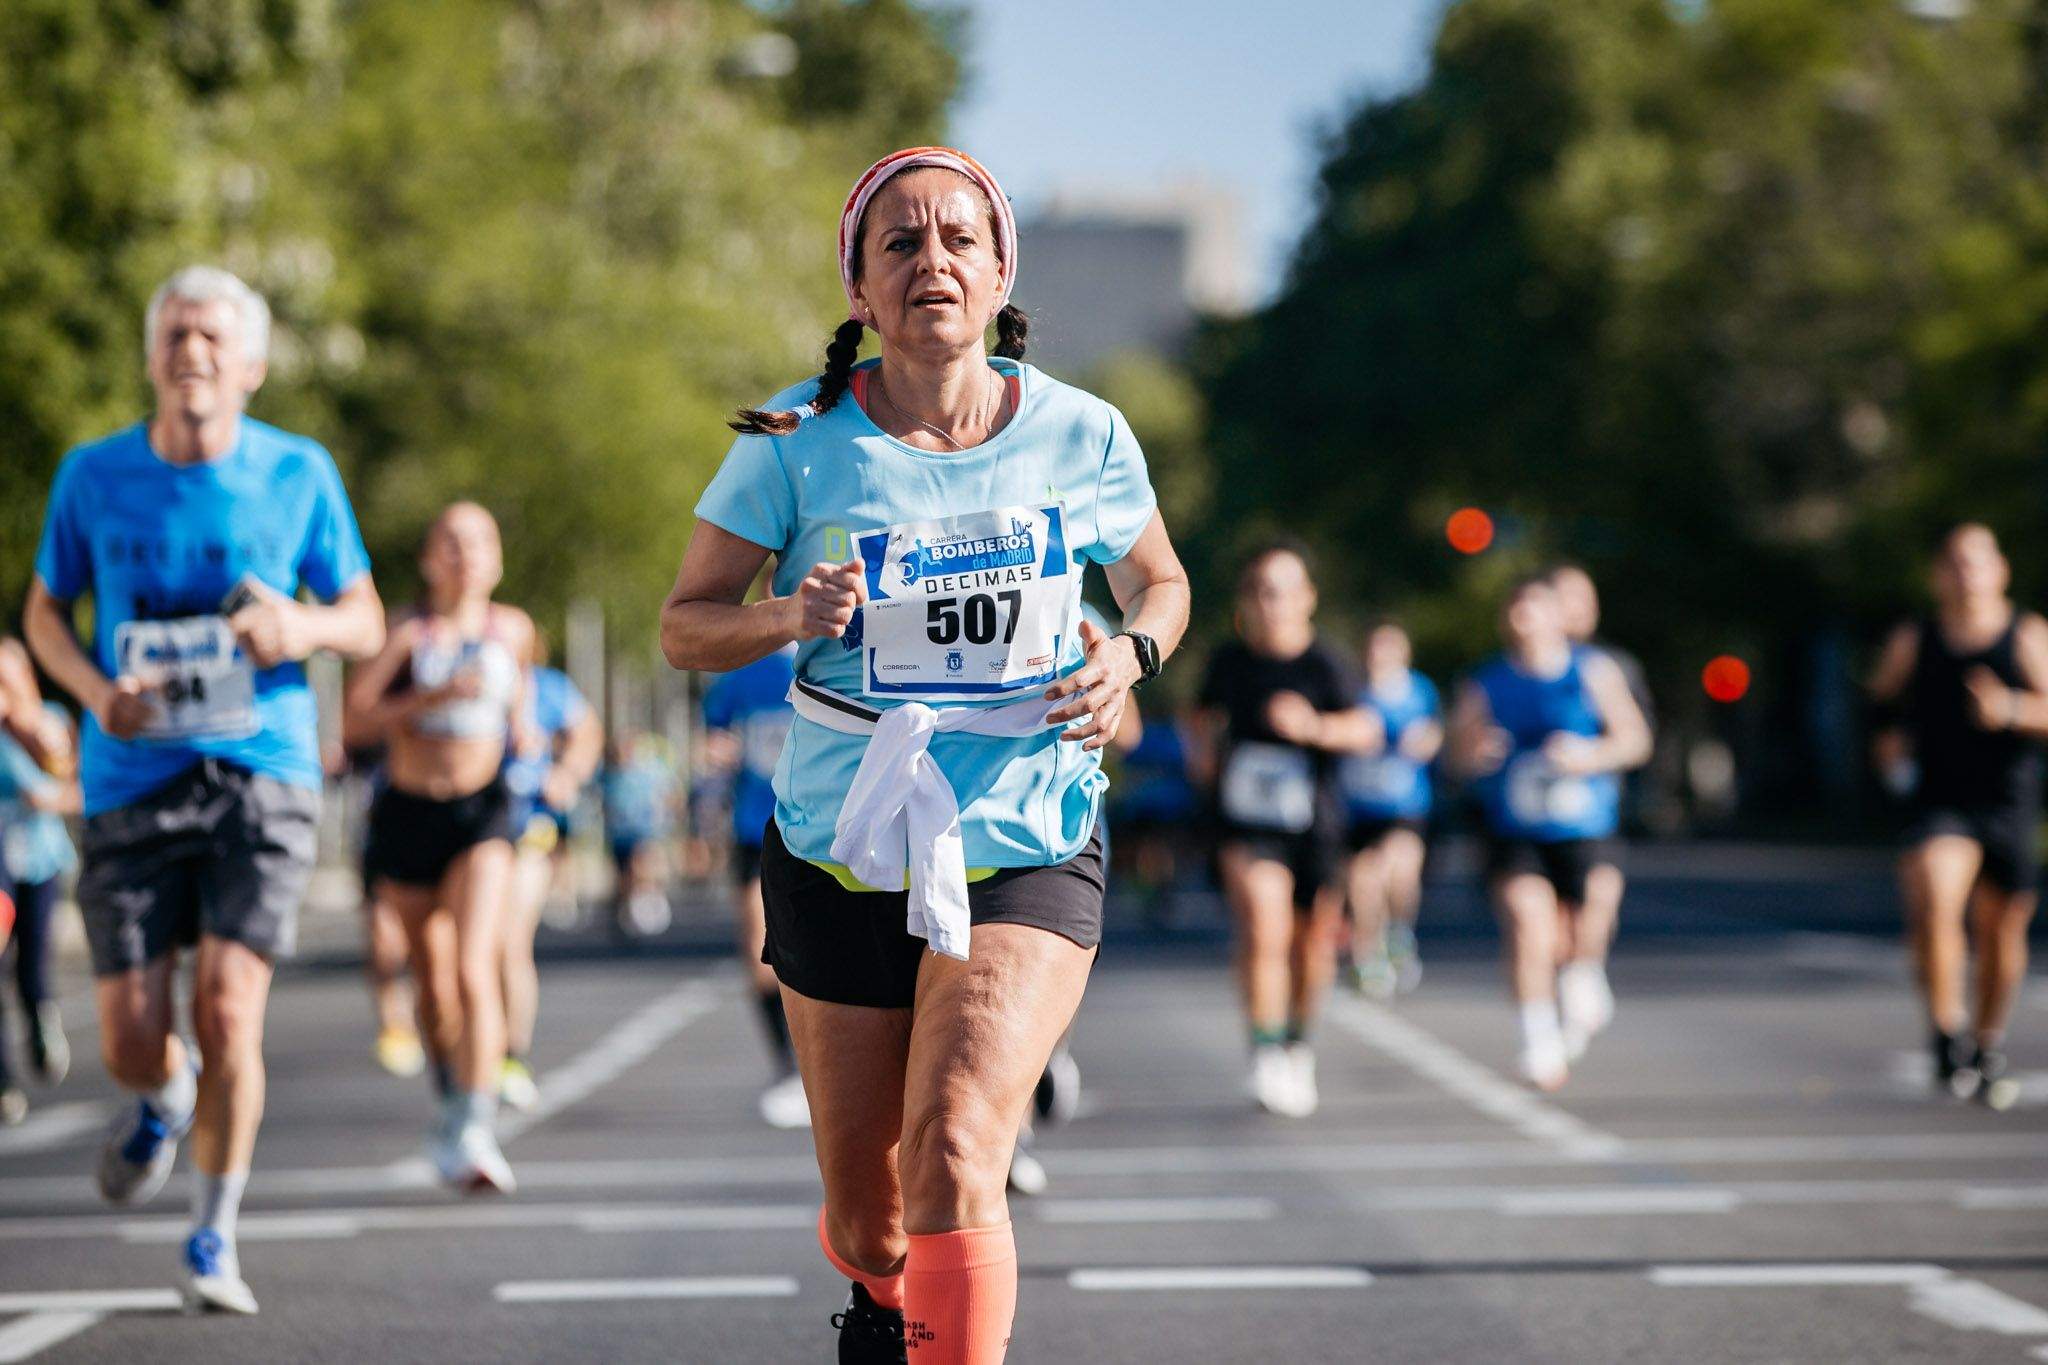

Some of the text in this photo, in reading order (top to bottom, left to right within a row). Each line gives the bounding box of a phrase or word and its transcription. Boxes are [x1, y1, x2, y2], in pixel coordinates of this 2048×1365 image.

[930, 533, 968, 544] CARRERA
[931, 533, 1031, 562] BOMBEROS
[972, 548, 1032, 569] de MADRID
[925, 567, 1032, 594] DECIMAS
[926, 590, 1022, 645] 507
[911, 1330, 935, 1341] AND
